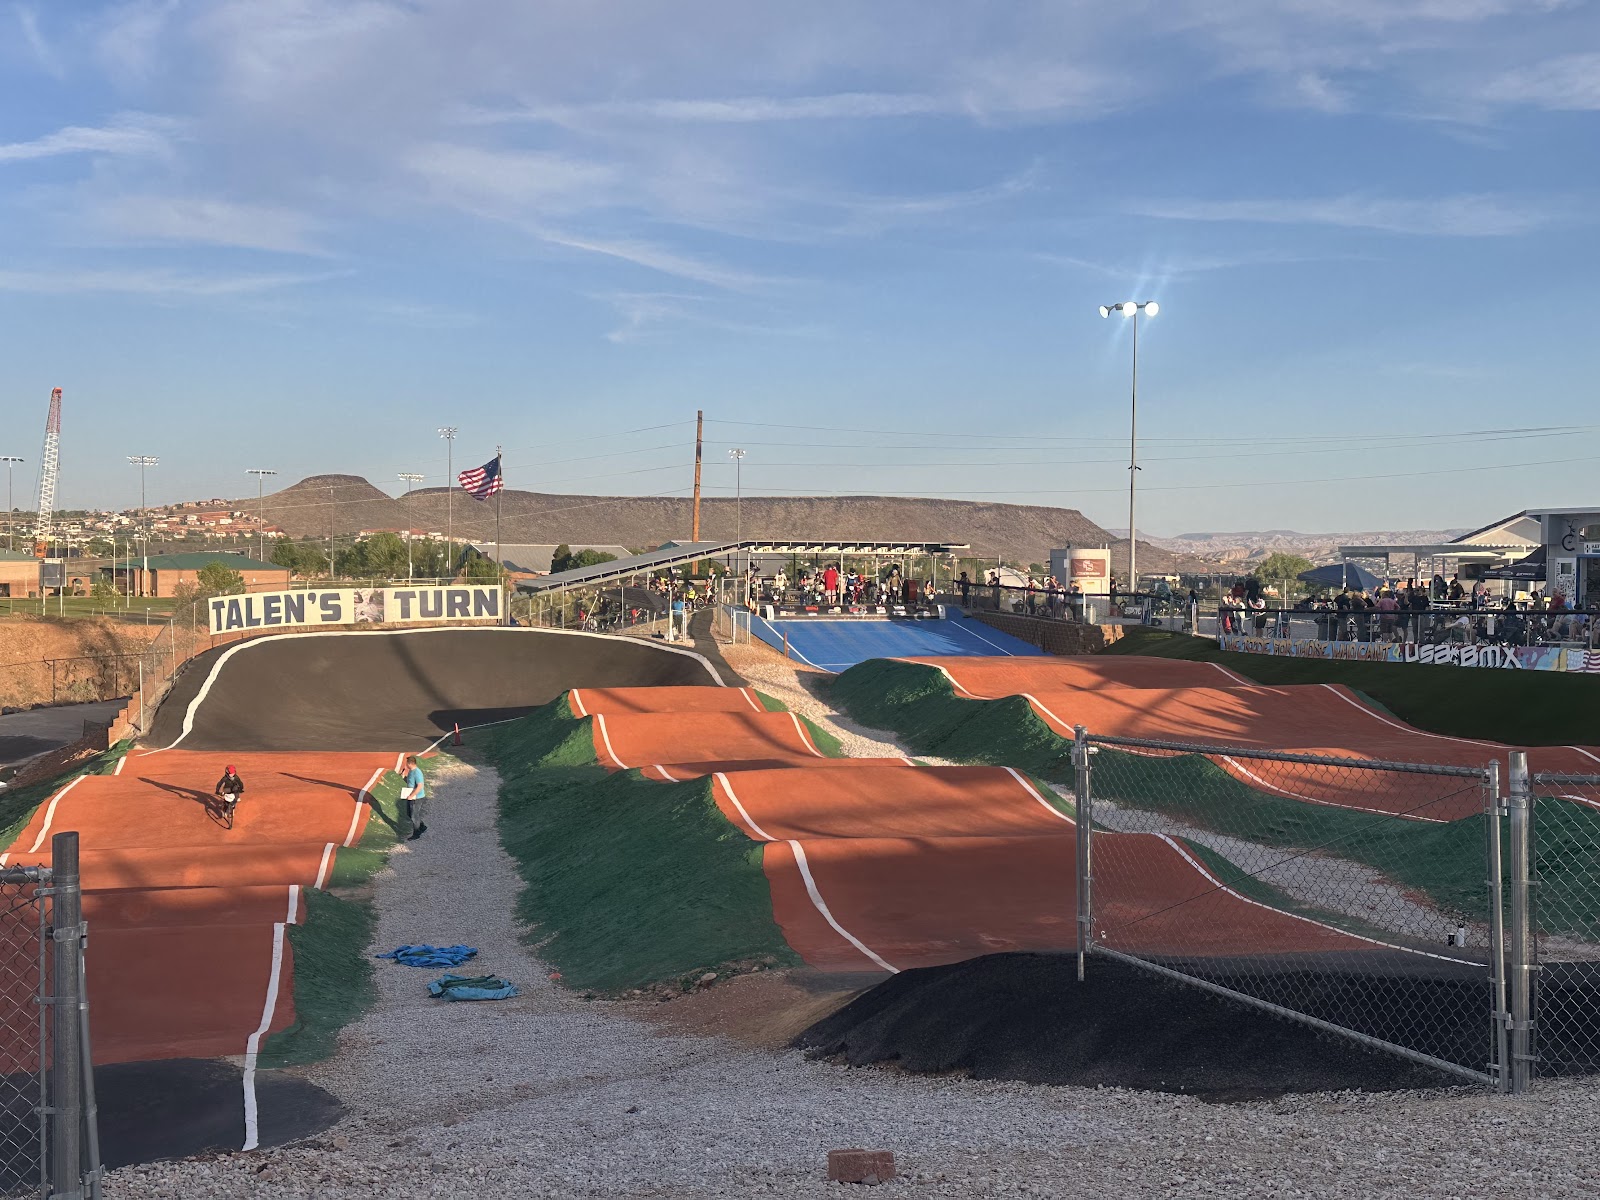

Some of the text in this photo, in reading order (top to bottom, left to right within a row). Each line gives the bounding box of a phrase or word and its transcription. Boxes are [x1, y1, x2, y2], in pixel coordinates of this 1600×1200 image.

[211, 588, 499, 632] TALEN'S TURN
[1274, 639, 1293, 657] FOR
[1295, 639, 1327, 659] THOSE
[1332, 643, 1358, 660] WHO
